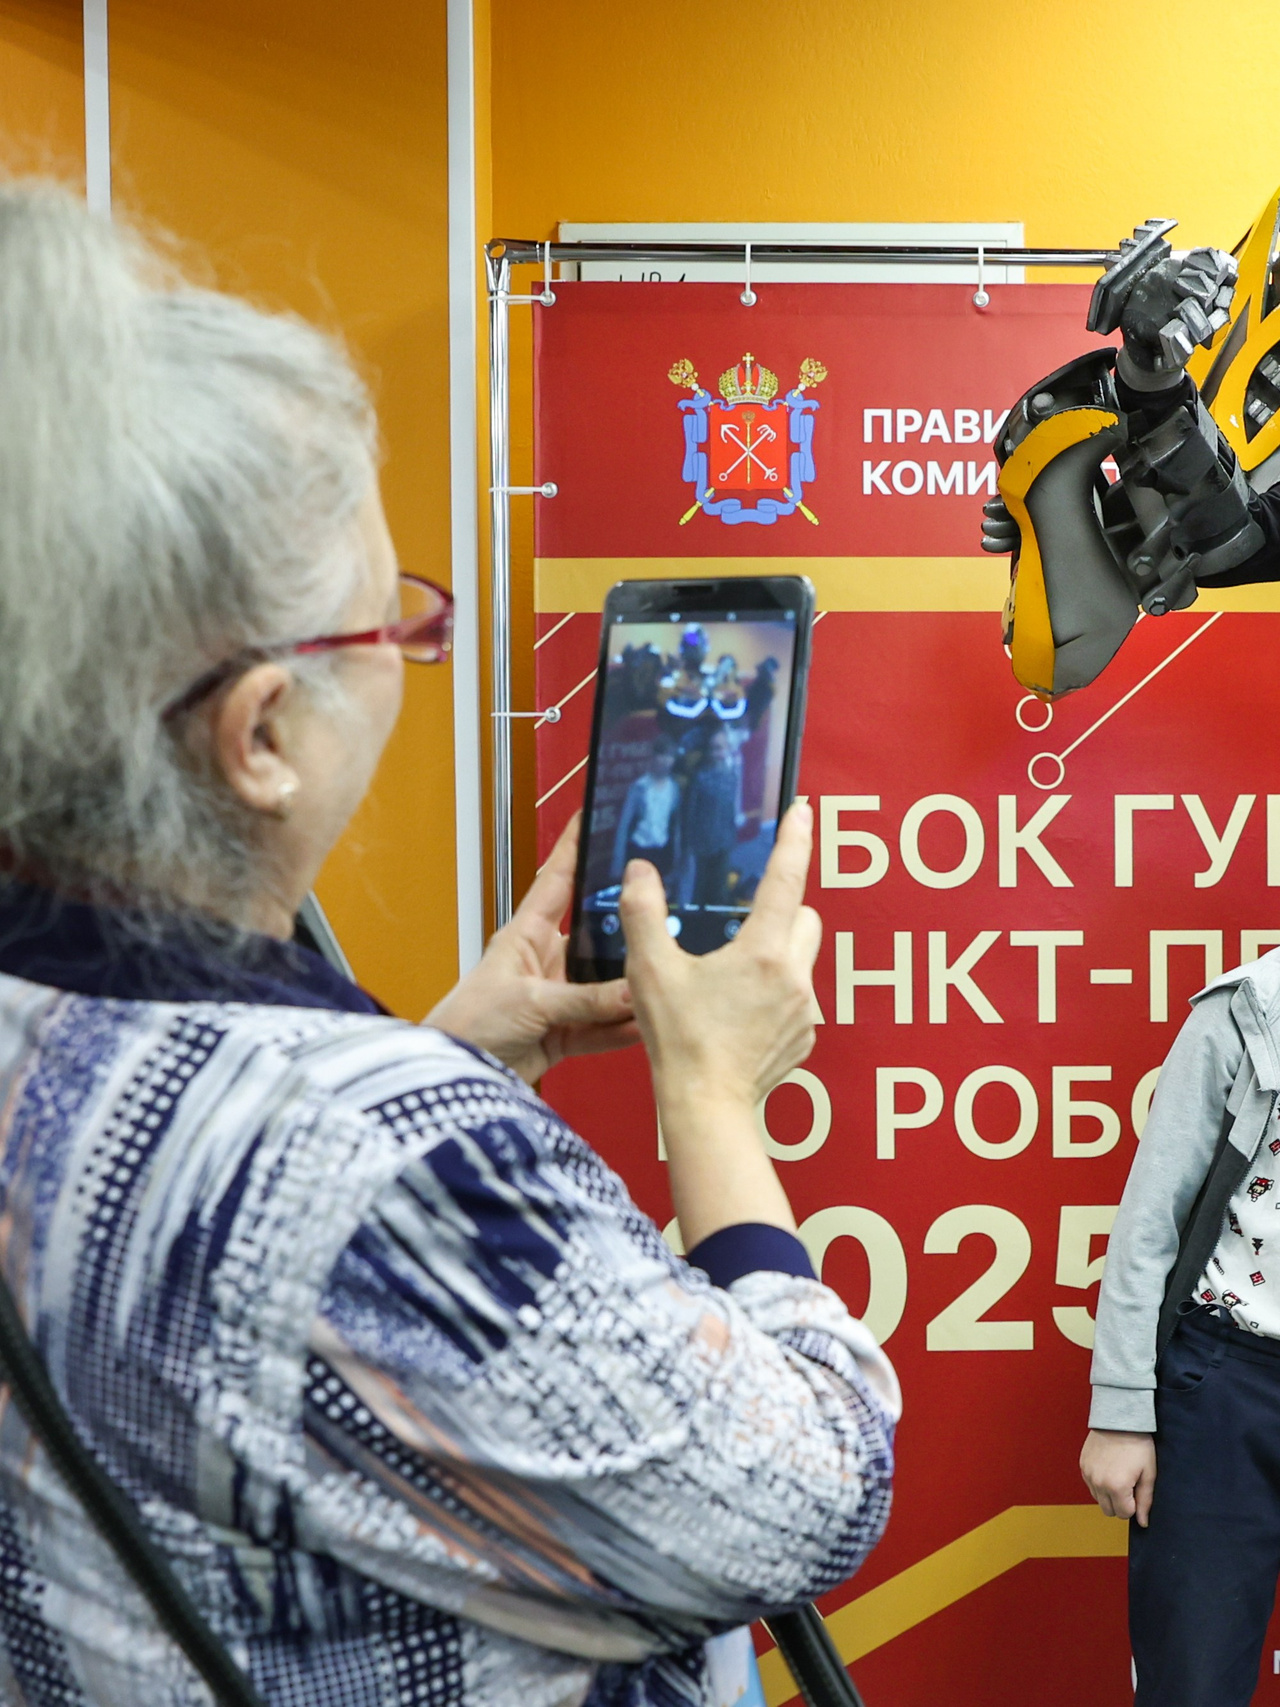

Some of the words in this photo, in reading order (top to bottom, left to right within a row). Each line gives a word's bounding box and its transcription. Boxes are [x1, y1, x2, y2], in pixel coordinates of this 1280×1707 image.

[862, 460, 999, 496] КОМИ
[795, 793, 1073, 890] БОК
[661, 1204, 1121, 1353] 025
